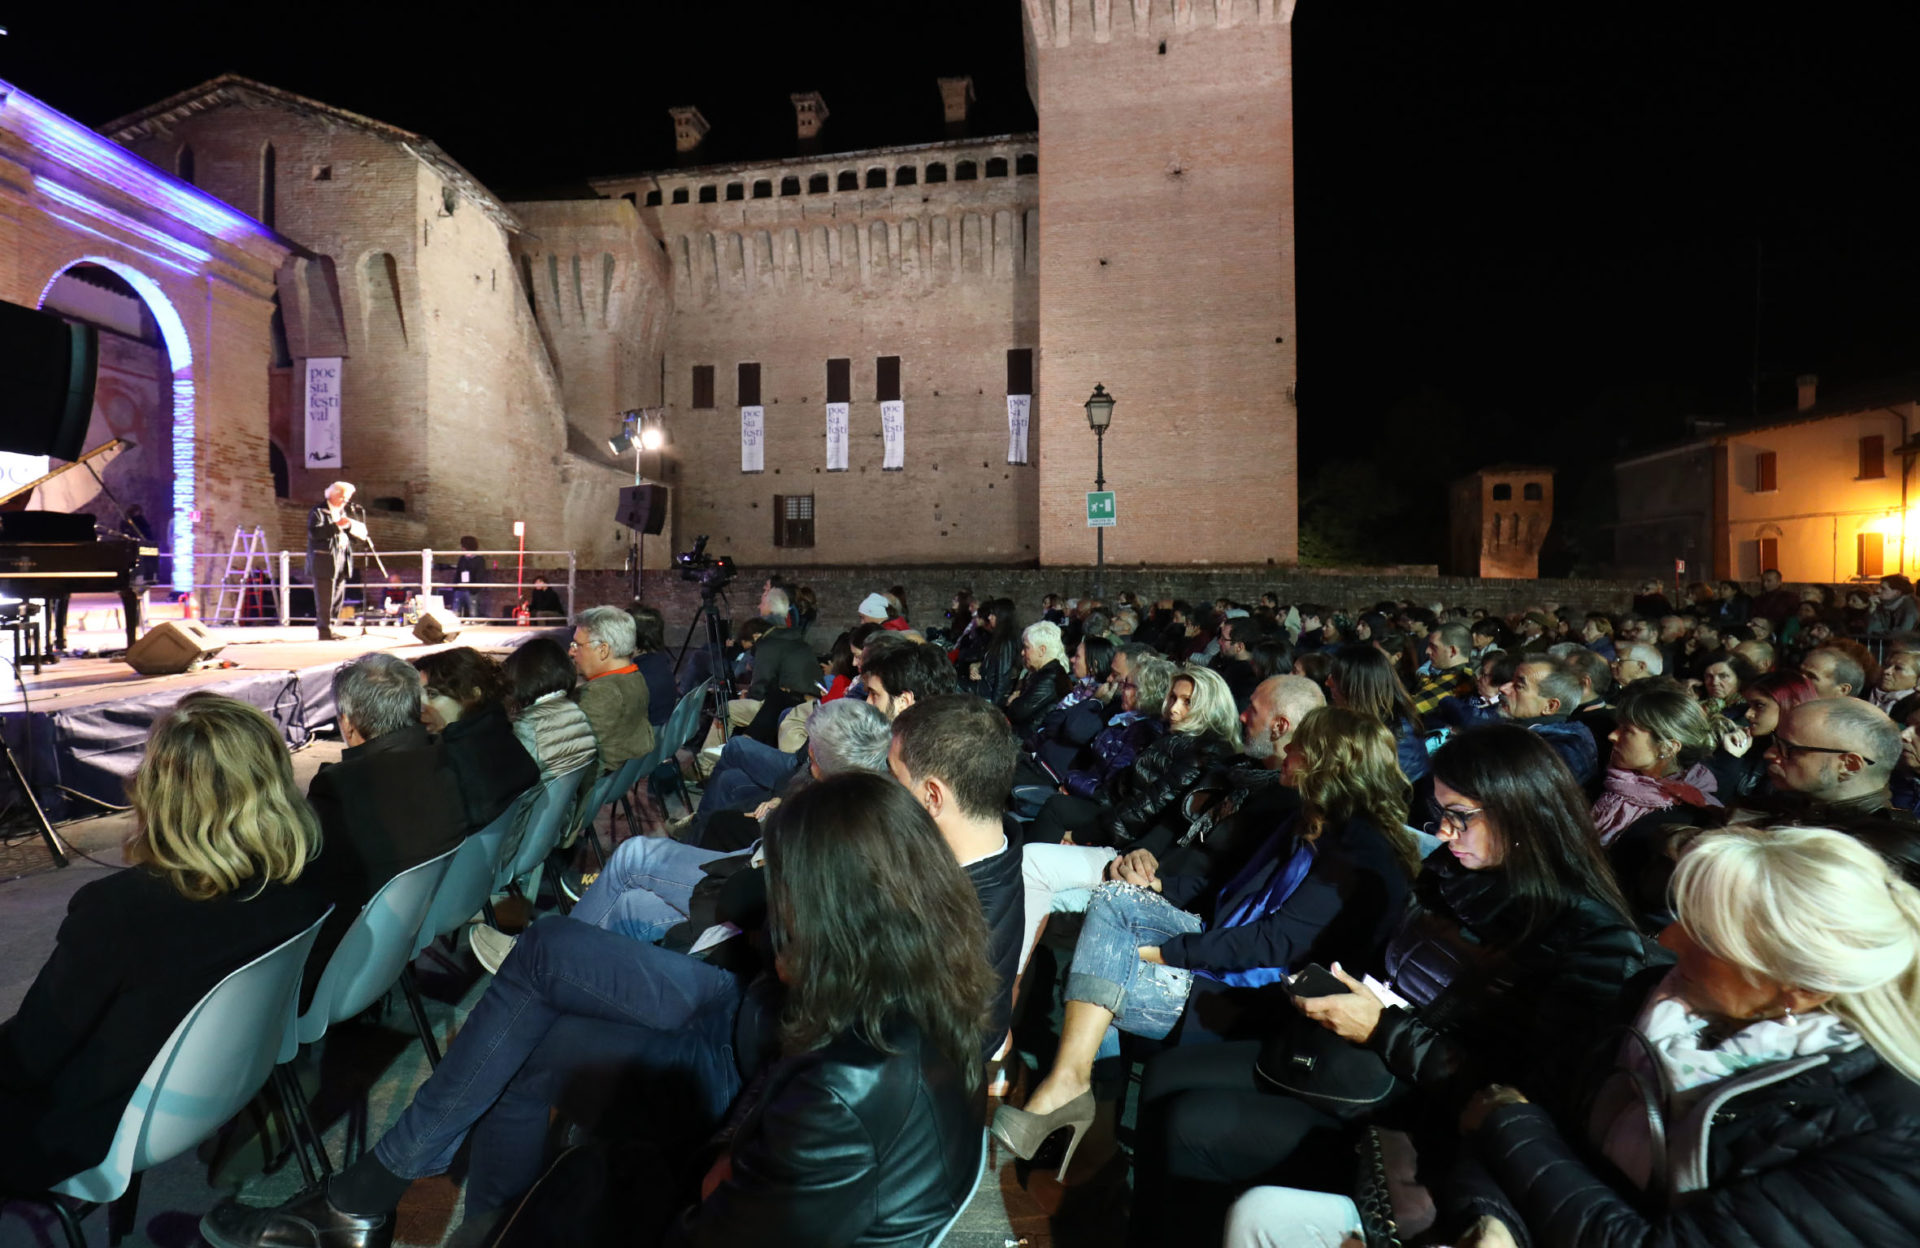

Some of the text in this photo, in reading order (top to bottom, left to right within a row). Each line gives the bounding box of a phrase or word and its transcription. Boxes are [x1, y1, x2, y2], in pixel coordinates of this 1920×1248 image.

[310, 368, 336, 382] poe
[310, 380, 328, 392] sia
[310, 394, 338, 407] festi
[310, 408, 329, 421] val
